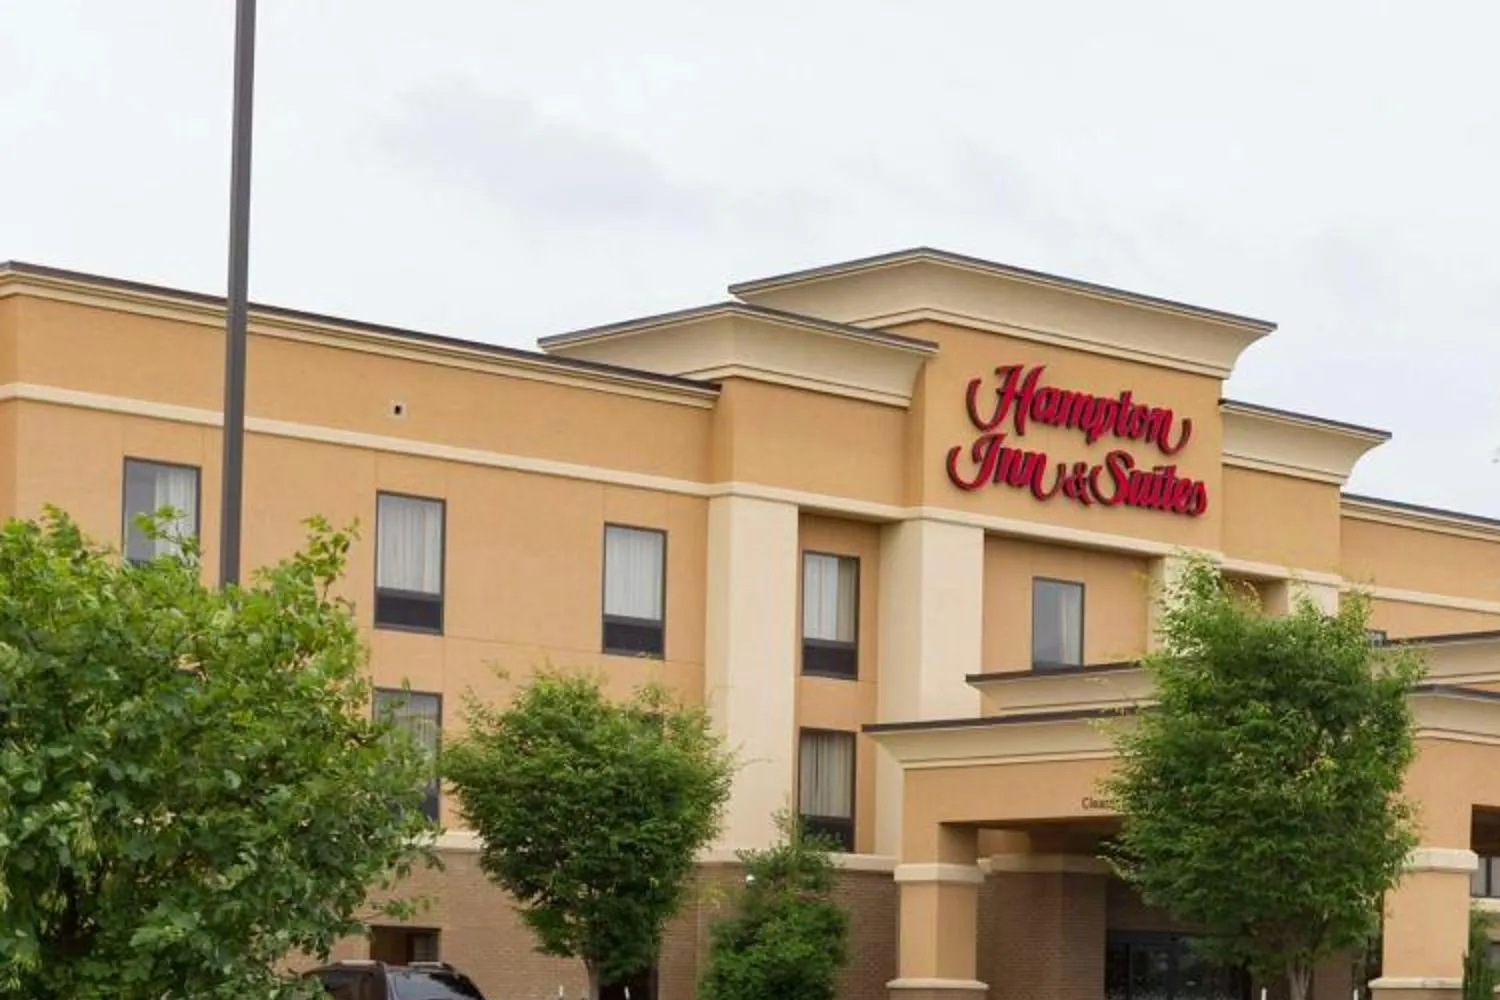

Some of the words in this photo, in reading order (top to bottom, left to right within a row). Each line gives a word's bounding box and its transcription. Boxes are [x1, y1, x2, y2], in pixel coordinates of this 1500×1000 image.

[966, 364, 1192, 455] Hampton
[946, 433, 1066, 501] Inn
[1063, 462, 1093, 507] &
[1089, 450, 1207, 517] Suites
